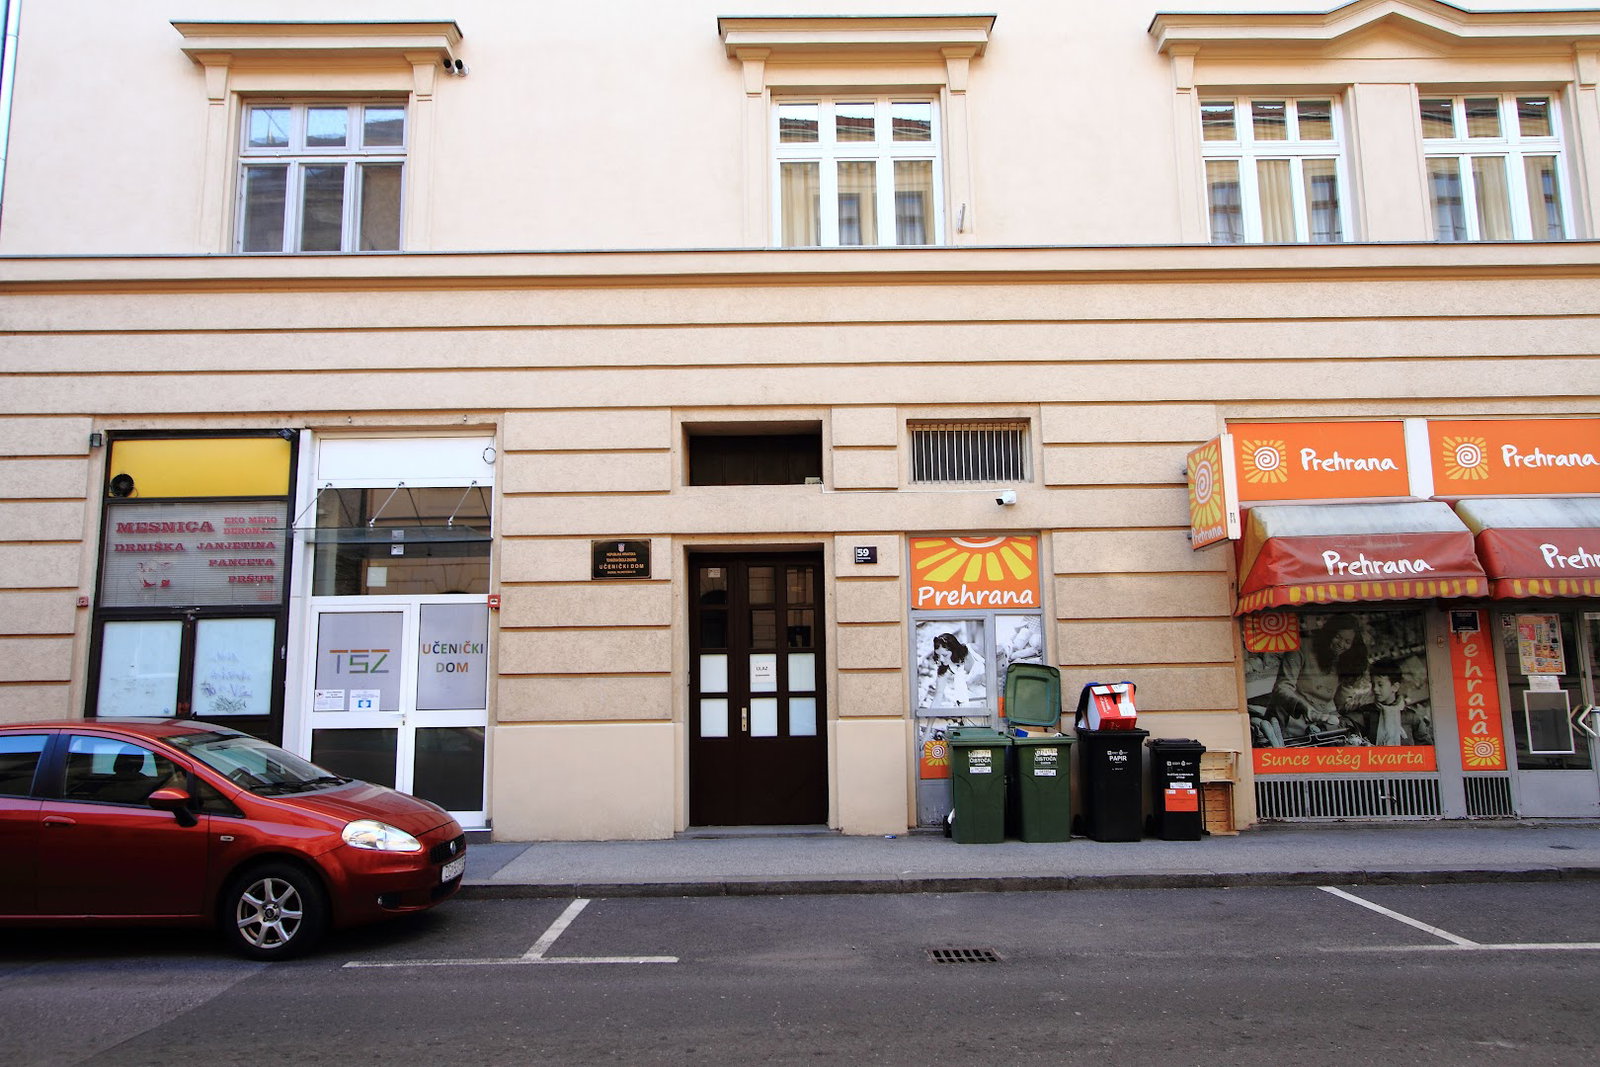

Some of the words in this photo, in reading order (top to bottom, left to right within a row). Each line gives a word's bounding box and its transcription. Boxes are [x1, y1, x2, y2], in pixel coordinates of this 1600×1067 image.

[1300, 448, 1398, 472] Prehrana
[1501, 444, 1600, 468] Prehrana
[116, 521, 215, 534] MESNICA
[1192, 526, 1224, 544] Prehrana
[114, 541, 185, 552] DRNIŠKA
[196, 542, 276, 550] JANJETINA
[857, 548, 870, 557] 59
[209, 559, 276, 567] PANCETA
[1322, 550, 1434, 576] Prehrana
[228, 575, 275, 584] PRŠUT
[918, 583, 1034, 606] Prehrana
[422, 641, 484, 655] UČENIČKI
[329, 649, 391, 674] TSZ
[436, 662, 469, 673] DOM
[1461, 630, 1489, 735] rehrana
[1261, 752, 1311, 767] Sunce
[1316, 749, 1362, 770] vašeg
[1368, 750, 1425, 766] kvarta
